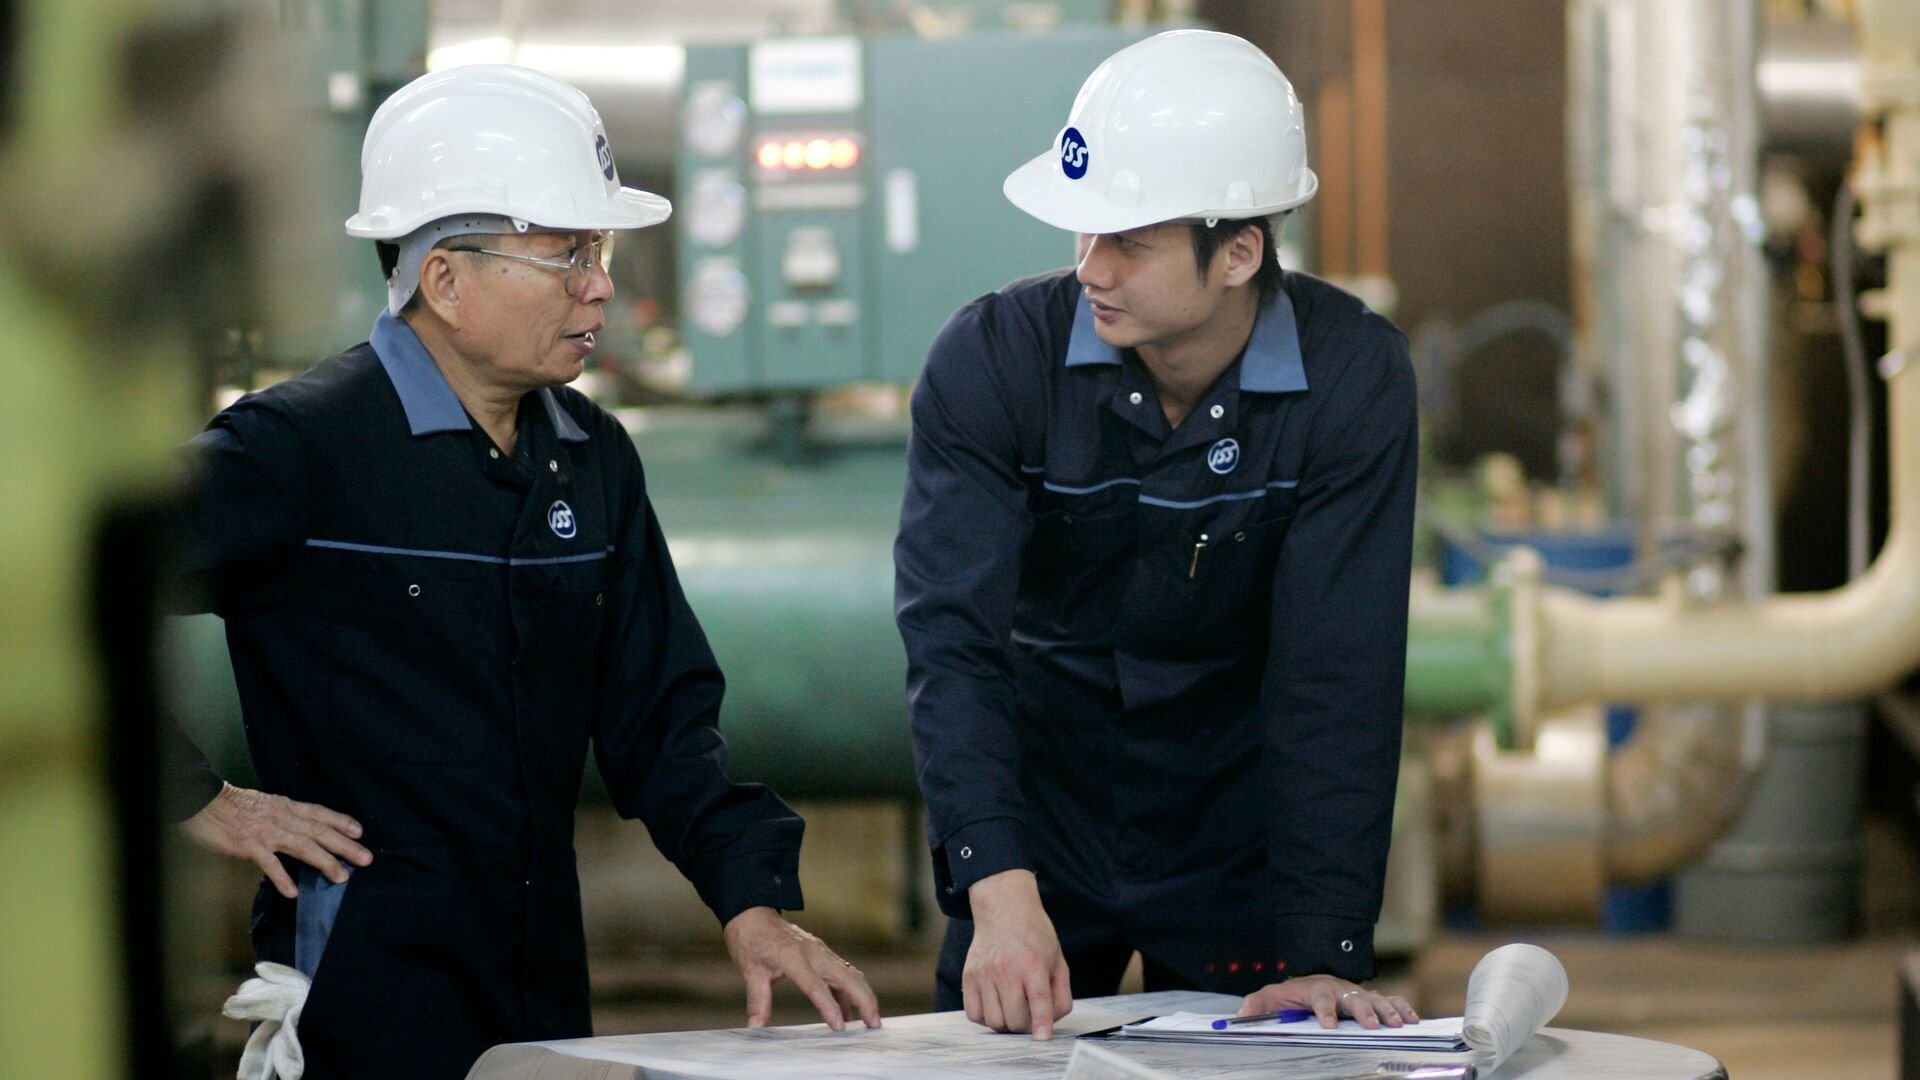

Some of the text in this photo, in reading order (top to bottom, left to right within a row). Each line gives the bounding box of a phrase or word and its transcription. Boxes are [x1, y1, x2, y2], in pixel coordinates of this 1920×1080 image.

[1062, 137, 1088, 168] ISS
[1210, 445, 1238, 467] ISS
[551, 509, 571, 529] ISS
